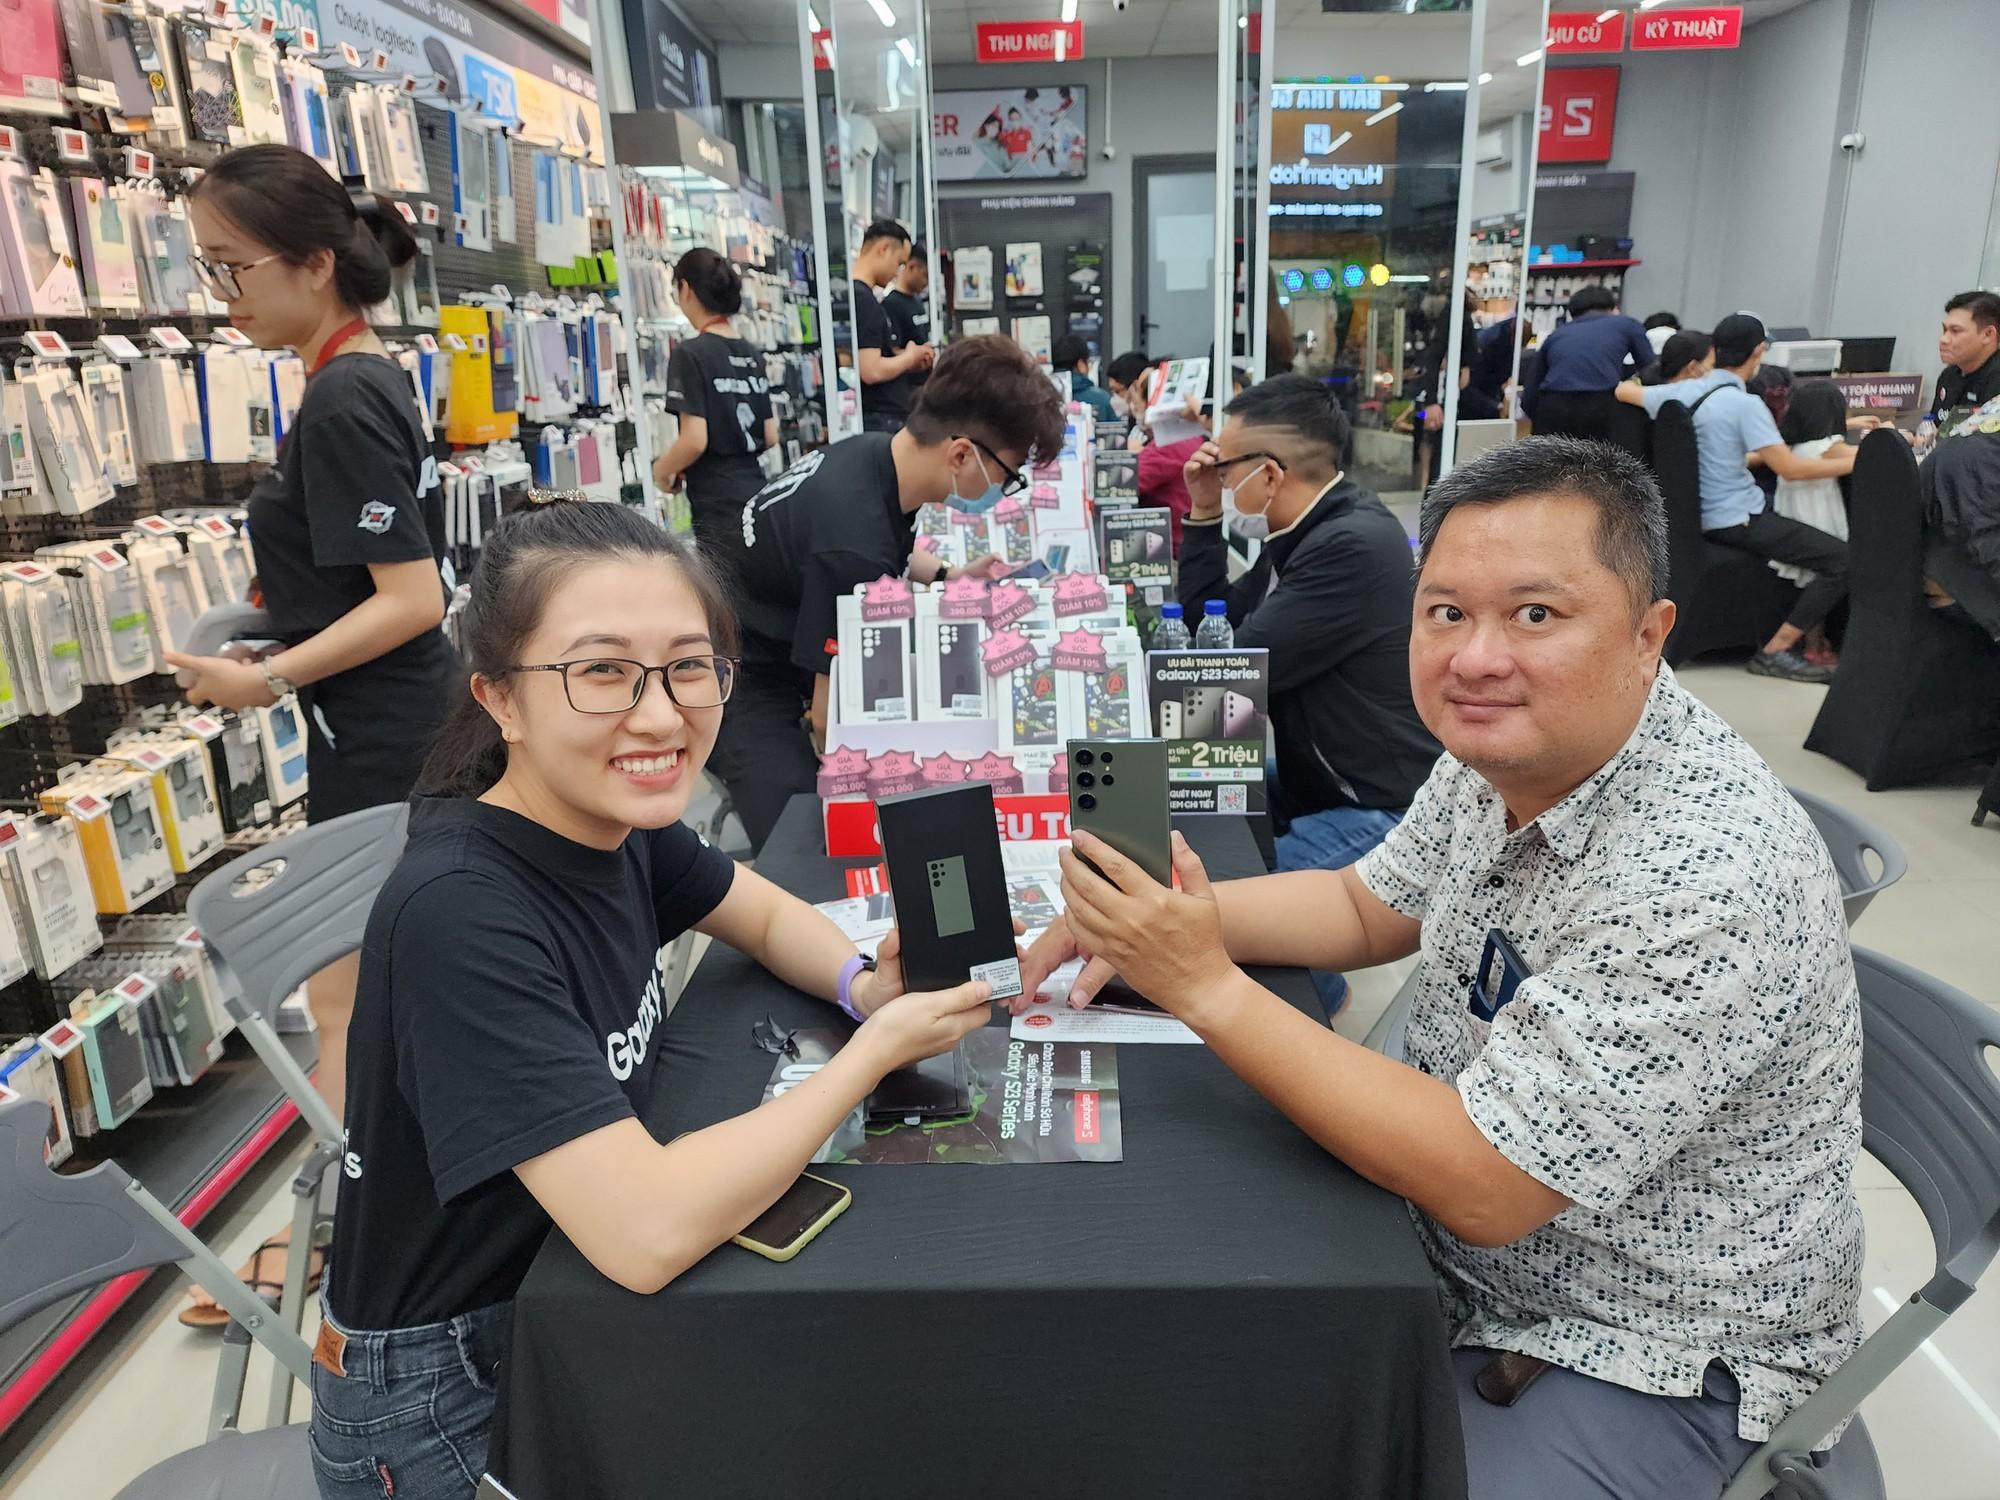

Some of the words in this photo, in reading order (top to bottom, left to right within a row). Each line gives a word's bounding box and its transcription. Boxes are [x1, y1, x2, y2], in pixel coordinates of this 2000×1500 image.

[1547, 28, 1573, 45] HU
[1645, 19, 1669, 39] KỸ
[1673, 17, 1727, 40] THUẬT
[988, 35, 1022, 53] THU
[1879, 383, 1915, 395] NHANH
[1129, 561, 1141, 578] 2
[891, 604, 910, 614] 10%
[1084, 598, 1103, 608] 10%
[1167, 658, 1179, 668] ƯU
[1180, 657, 1195, 668] ĐÃI
[1196, 658, 1224, 667] THANH
[1225, 656, 1250, 667] TOÁN
[1156, 669, 1200, 683] Galaxy
[1201, 668, 1222, 680] S23
[1223, 667, 1261, 680] Series
[1192, 741, 1210, 767] 2
[1211, 745, 1259, 767] Triệu
[831, 781, 867, 793] 390.000
[878, 783, 914, 796] 390.000
[1191, 789, 1213, 798] NGAY
[1184, 800, 1198, 809] CHI
[1001, 1042, 1025, 1078] Galaxy
[1080, 1050, 1092, 1085] SAMSUNG
[1004, 1081, 1022, 1099] S23
[1000, 1100, 1021, 1139] Series
[1023, 1101, 1036, 1121] Xanh
